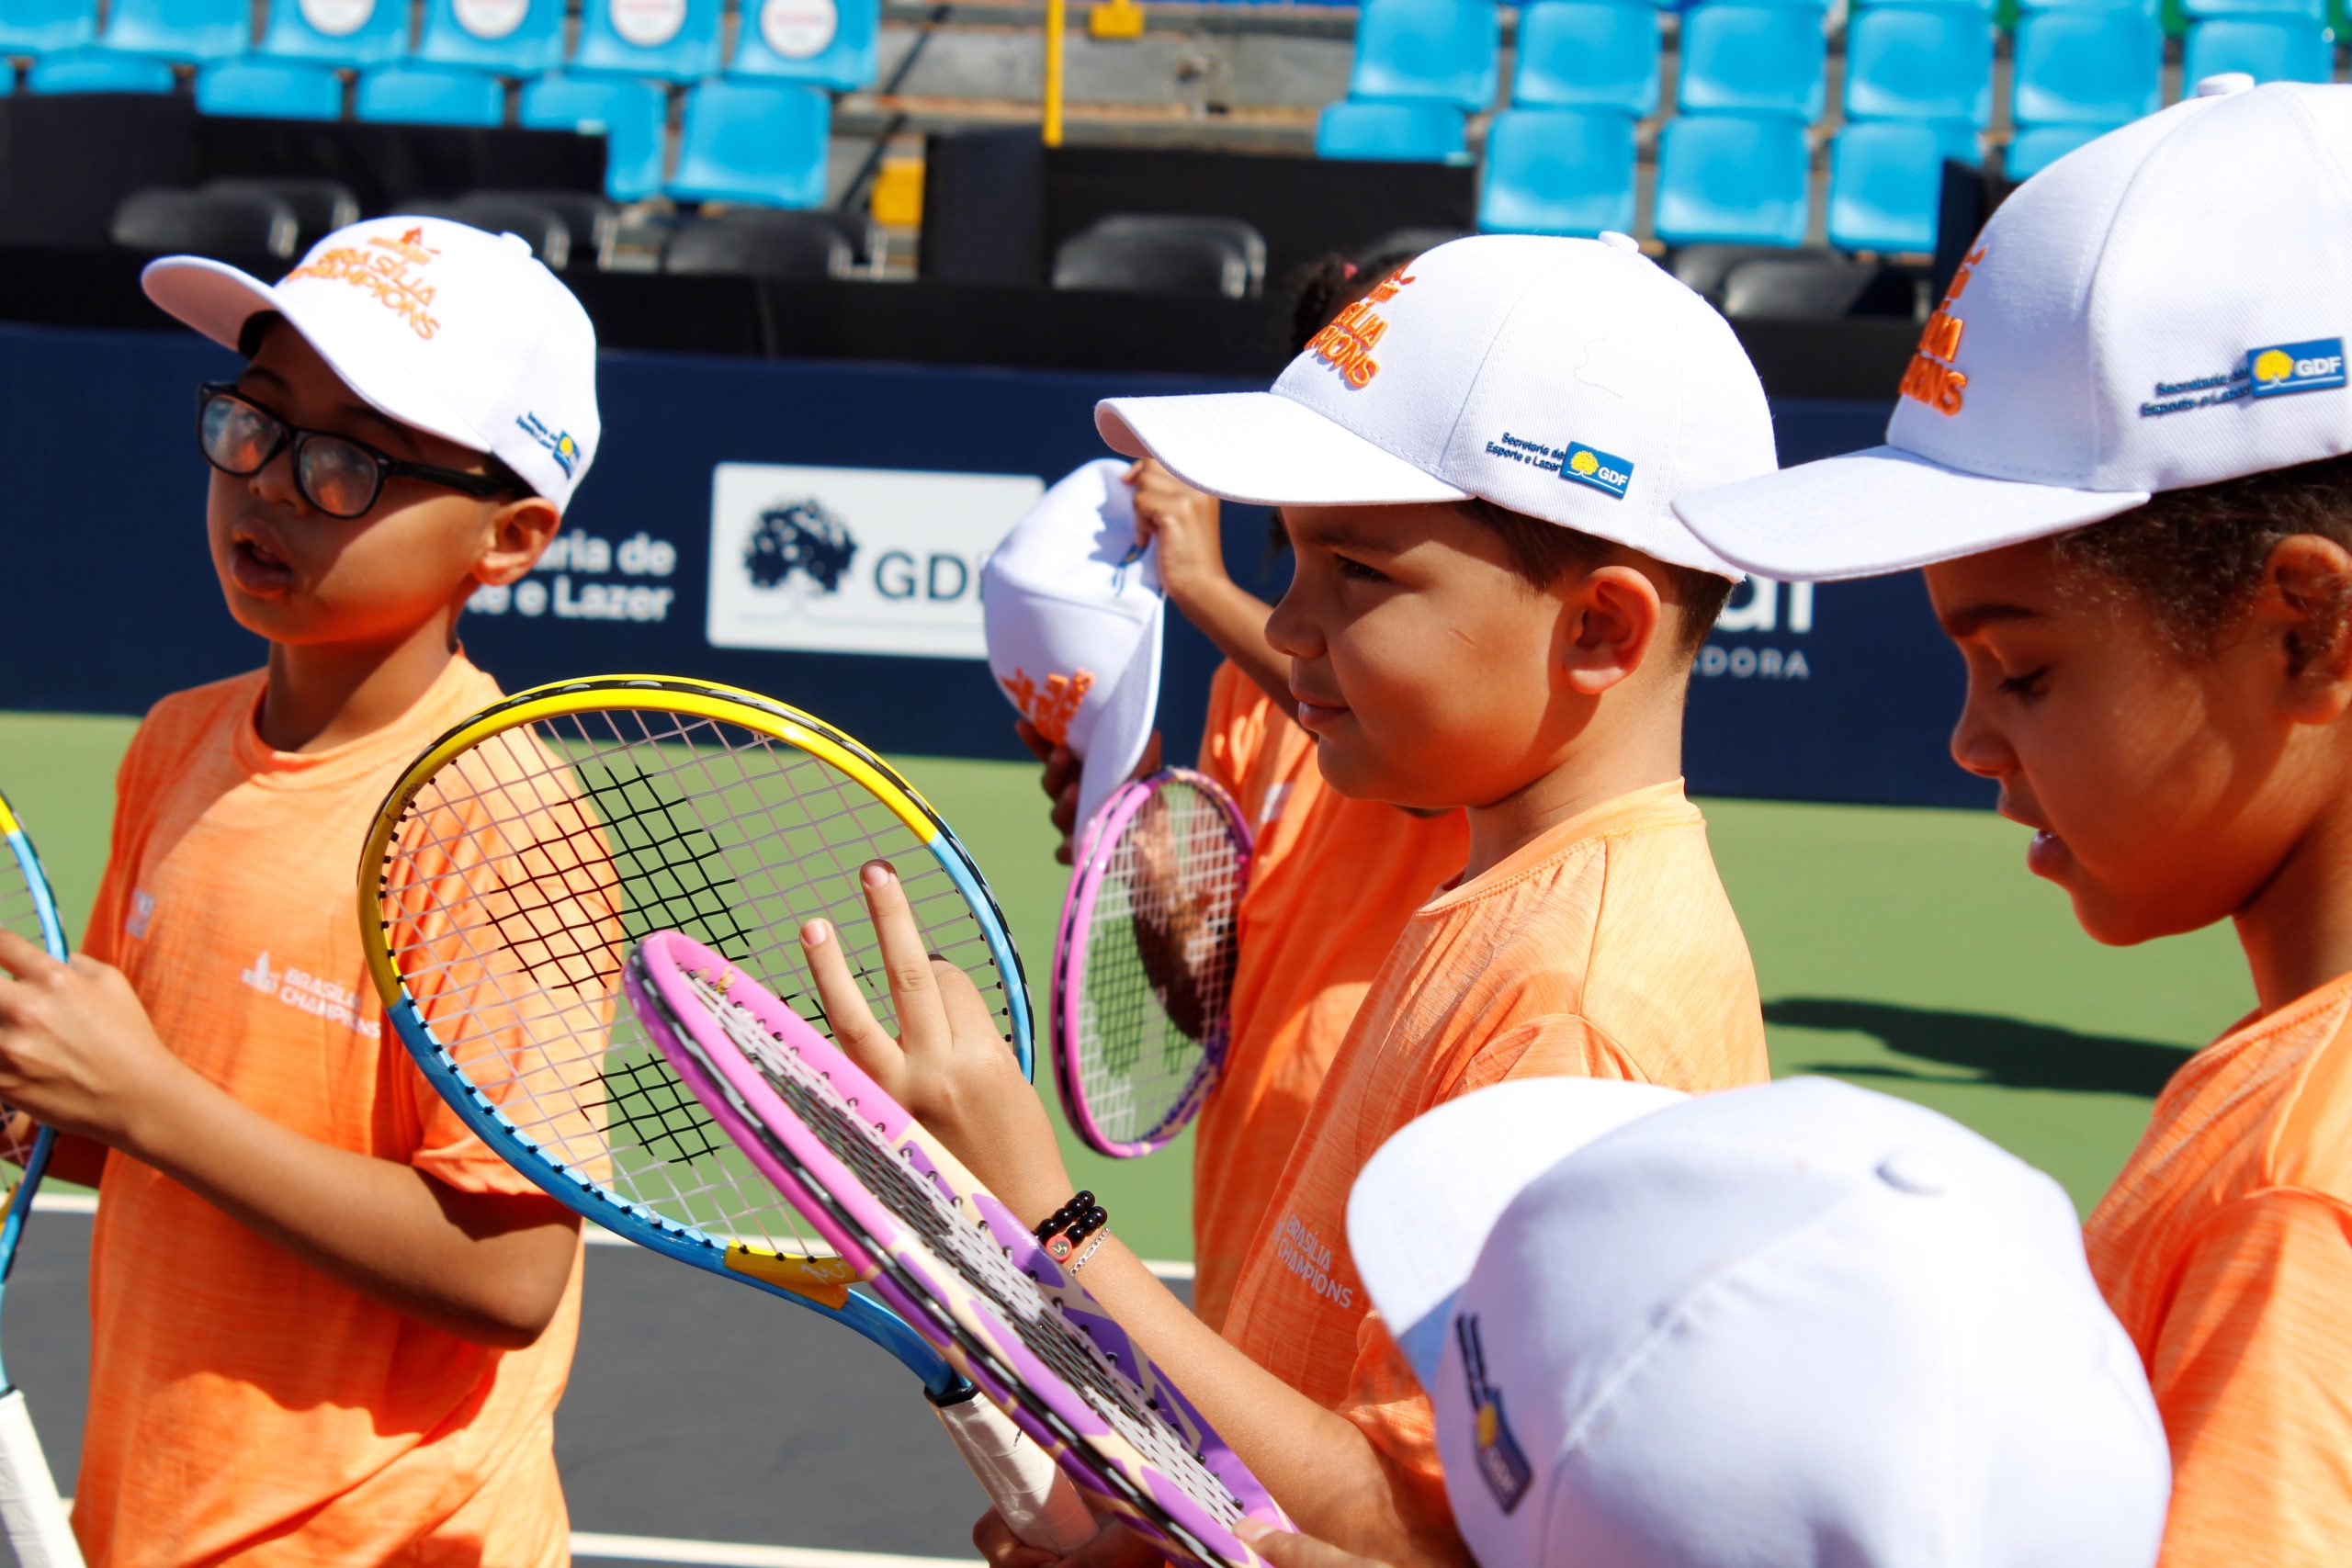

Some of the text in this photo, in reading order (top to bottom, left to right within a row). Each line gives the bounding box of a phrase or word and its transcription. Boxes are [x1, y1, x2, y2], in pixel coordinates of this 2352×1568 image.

[2296, 355, 2342, 377] GDF
[1486, 441, 1523, 462] Esporte
[1525, 455, 1532, 464] e
[1502, 432, 1550, 456] Secretaria
[1597, 467, 1628, 487] GDF
[874, 551, 983, 602] GD
[553, 574, 676, 622] Lazer
[1286, 1213, 1331, 1271] BRASÍLIA
[1278, 1237, 1353, 1308] CHAMPIONS
